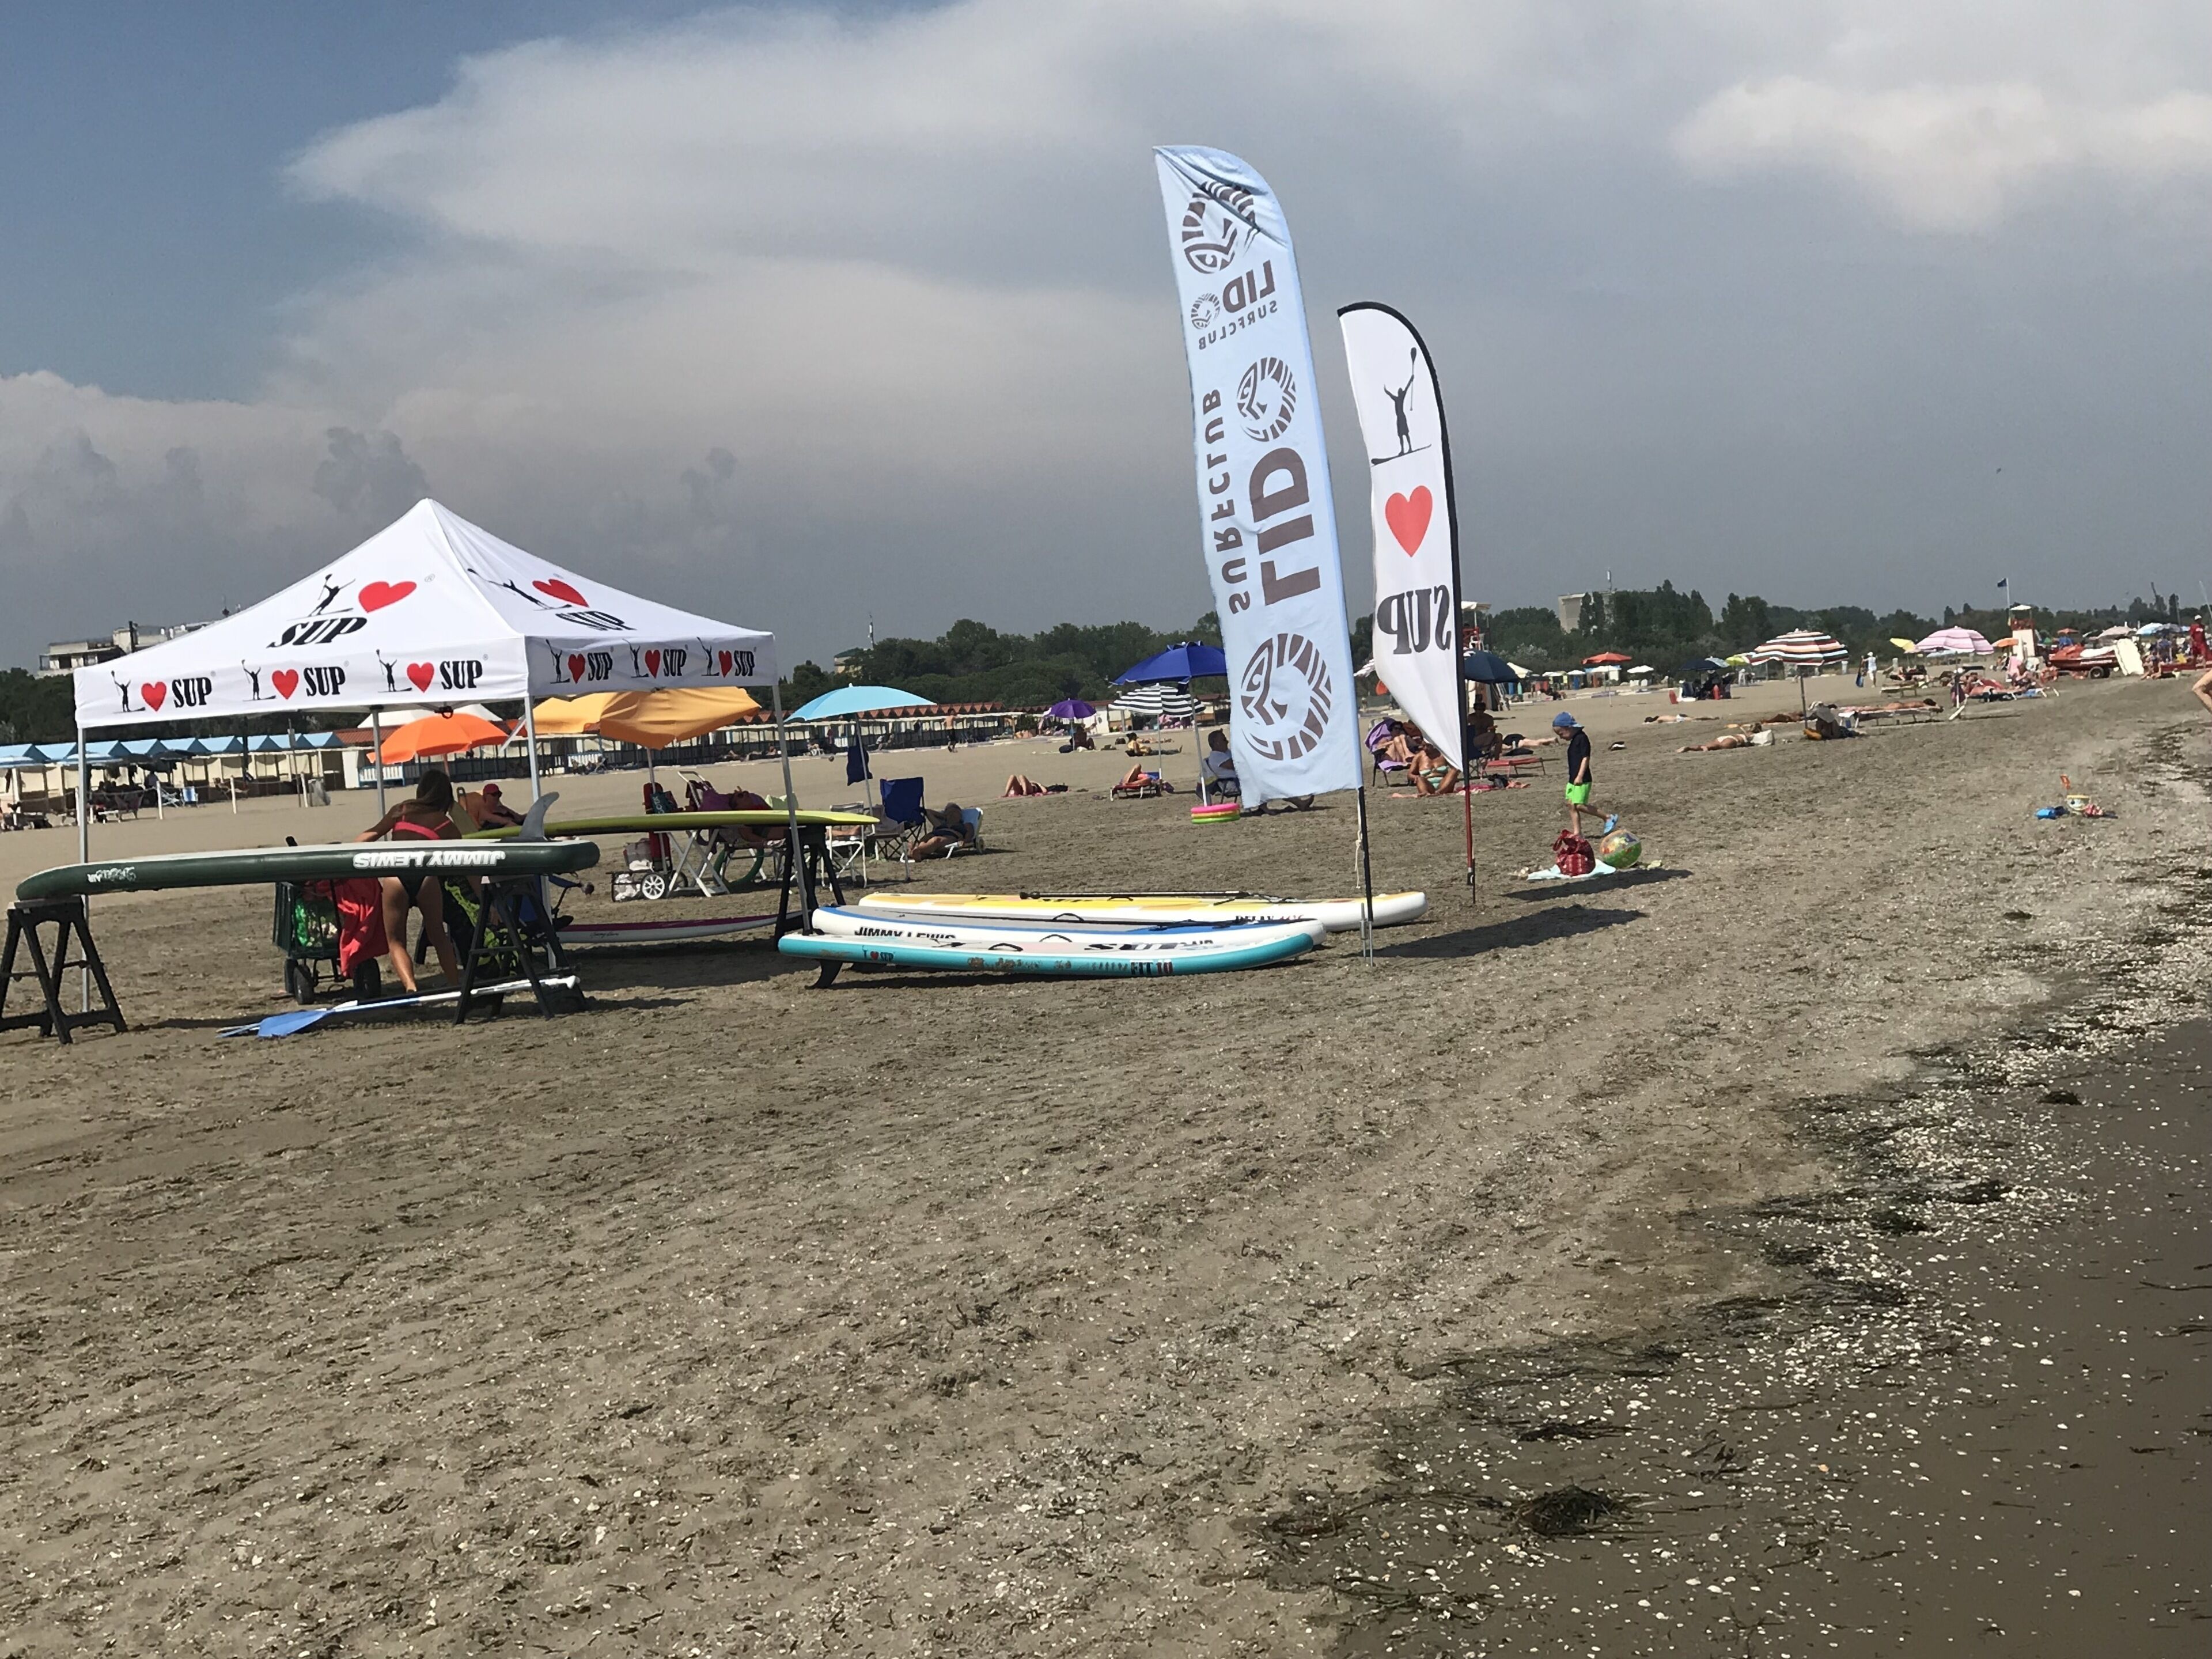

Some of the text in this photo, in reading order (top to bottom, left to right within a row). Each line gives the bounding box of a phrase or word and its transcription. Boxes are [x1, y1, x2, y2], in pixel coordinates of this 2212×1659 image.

[266, 617, 368, 649] SUP
[440, 660, 483, 690] SUP
[587, 652, 613, 681] SUP
[662, 649, 687, 677] SUP
[733, 650, 755, 676] SUP
[172, 677, 212, 708] SUP
[303, 666, 346, 696] SUP
[353, 850, 506, 869] JIMMY LEWIS
